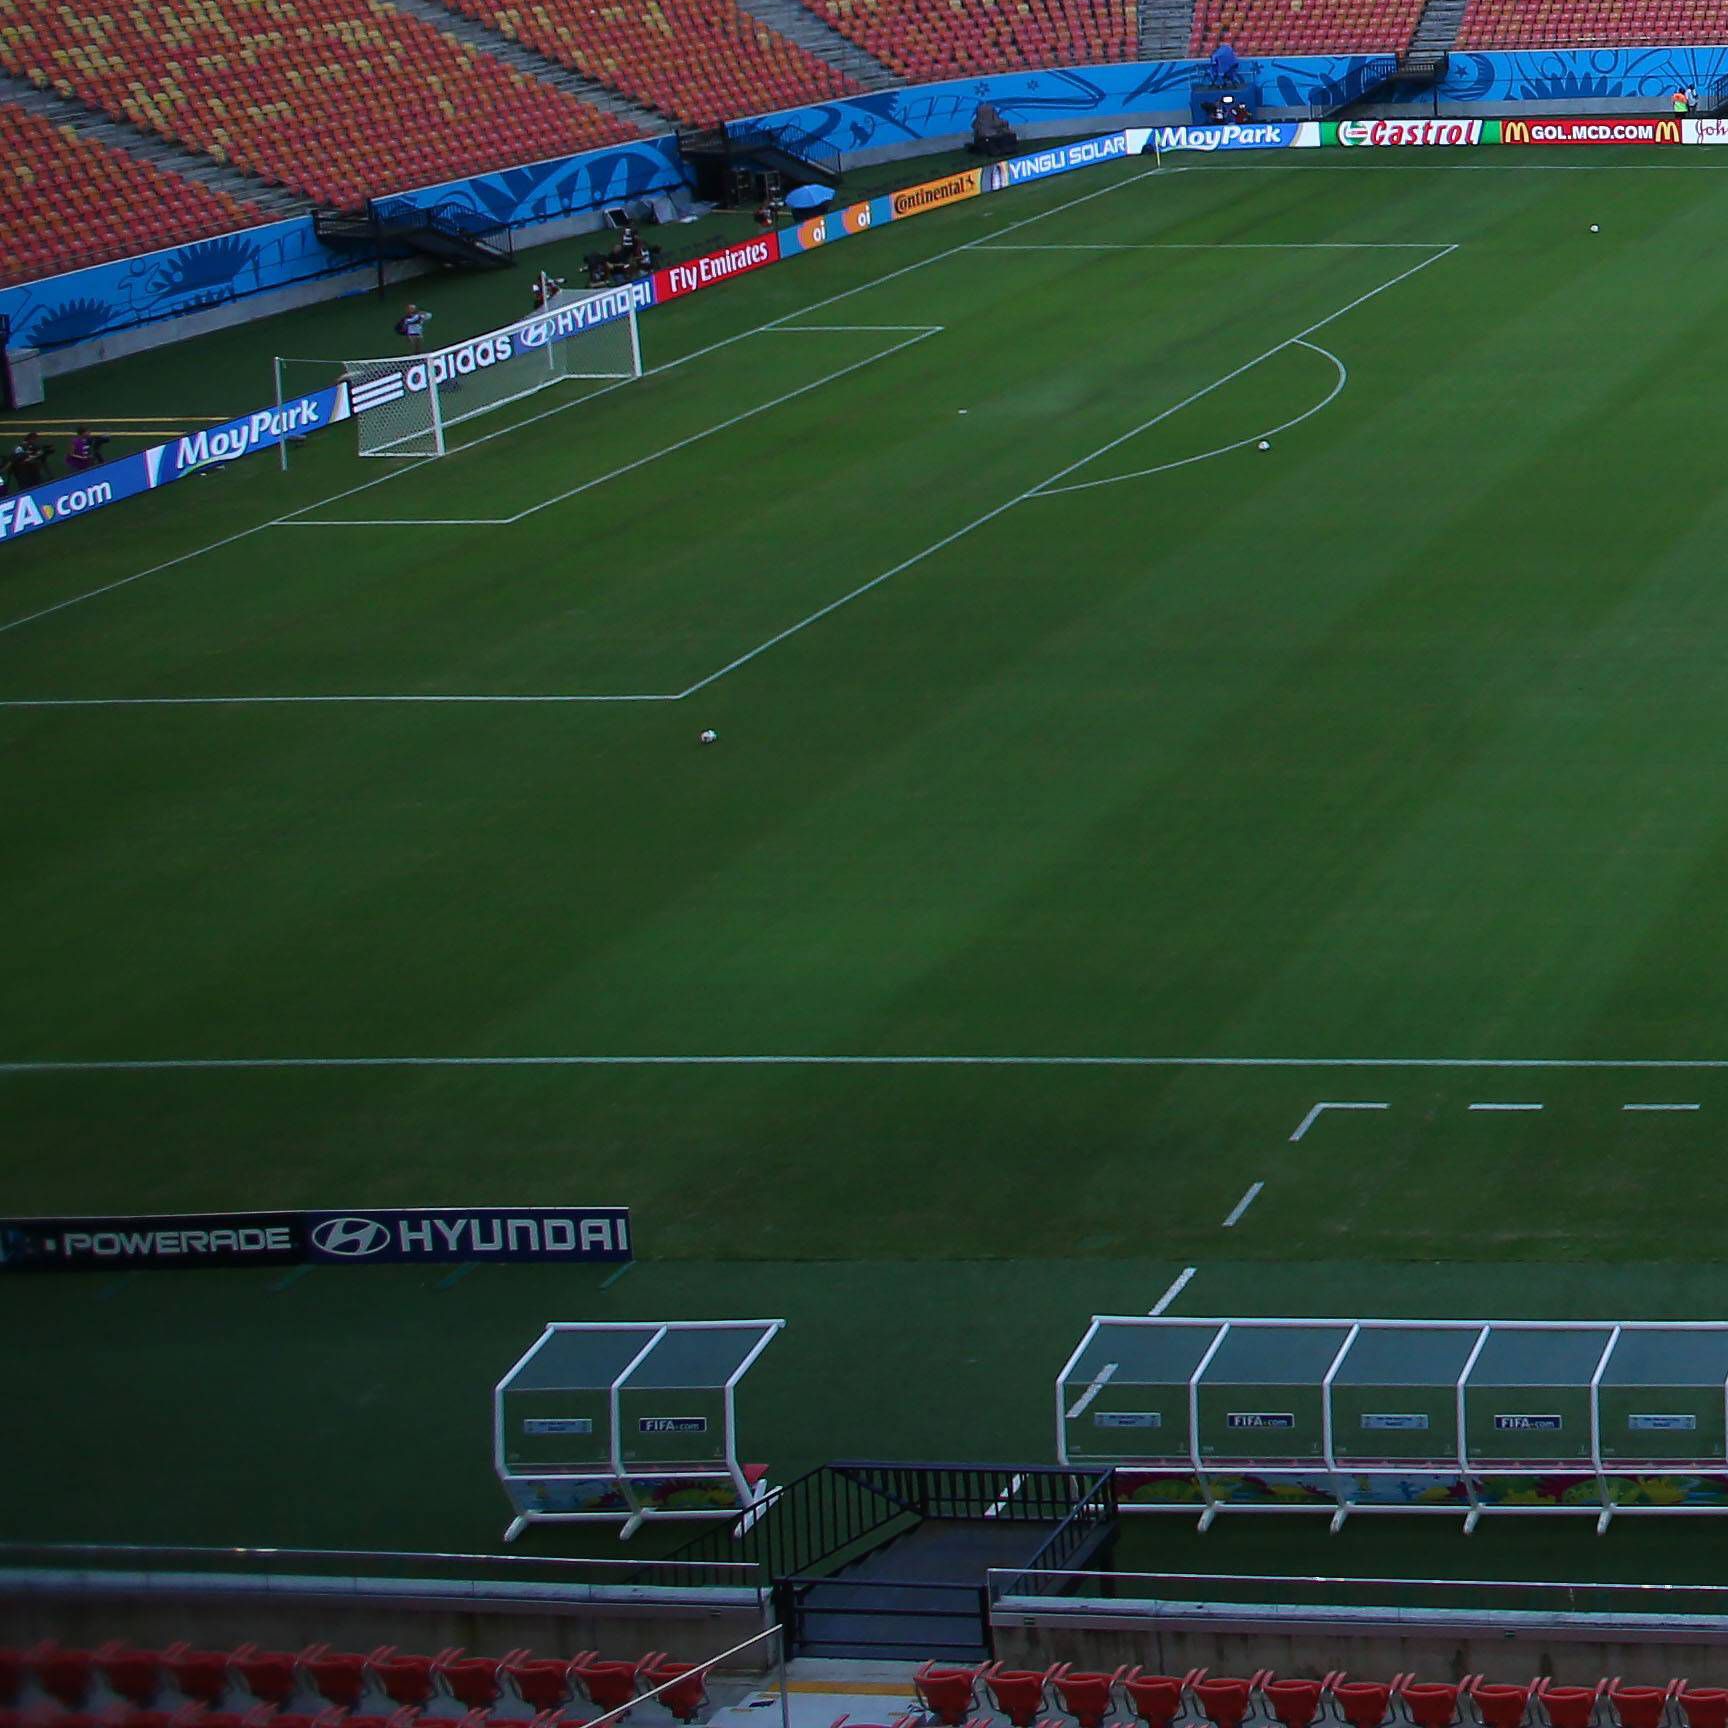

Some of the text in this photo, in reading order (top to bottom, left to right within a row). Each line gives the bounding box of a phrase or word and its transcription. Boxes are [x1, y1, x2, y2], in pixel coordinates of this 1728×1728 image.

[1370, 119, 1475, 145] Castrol
[1531, 125, 1653, 140] GOL.MCD.COM
[1009, 136, 1126, 179] YINGLI SOLAR
[894, 176, 965, 214] Continental
[813, 221, 826, 242] oi
[857, 205, 871, 227] oi
[670, 242, 769, 292] Fly Emirates
[558, 281, 652, 335] HYUNDAI
[406, 335, 512, 392] adidas
[63, 1227, 292, 1256] POWERADE
[398, 1219, 627, 1252] HYUNDAI
